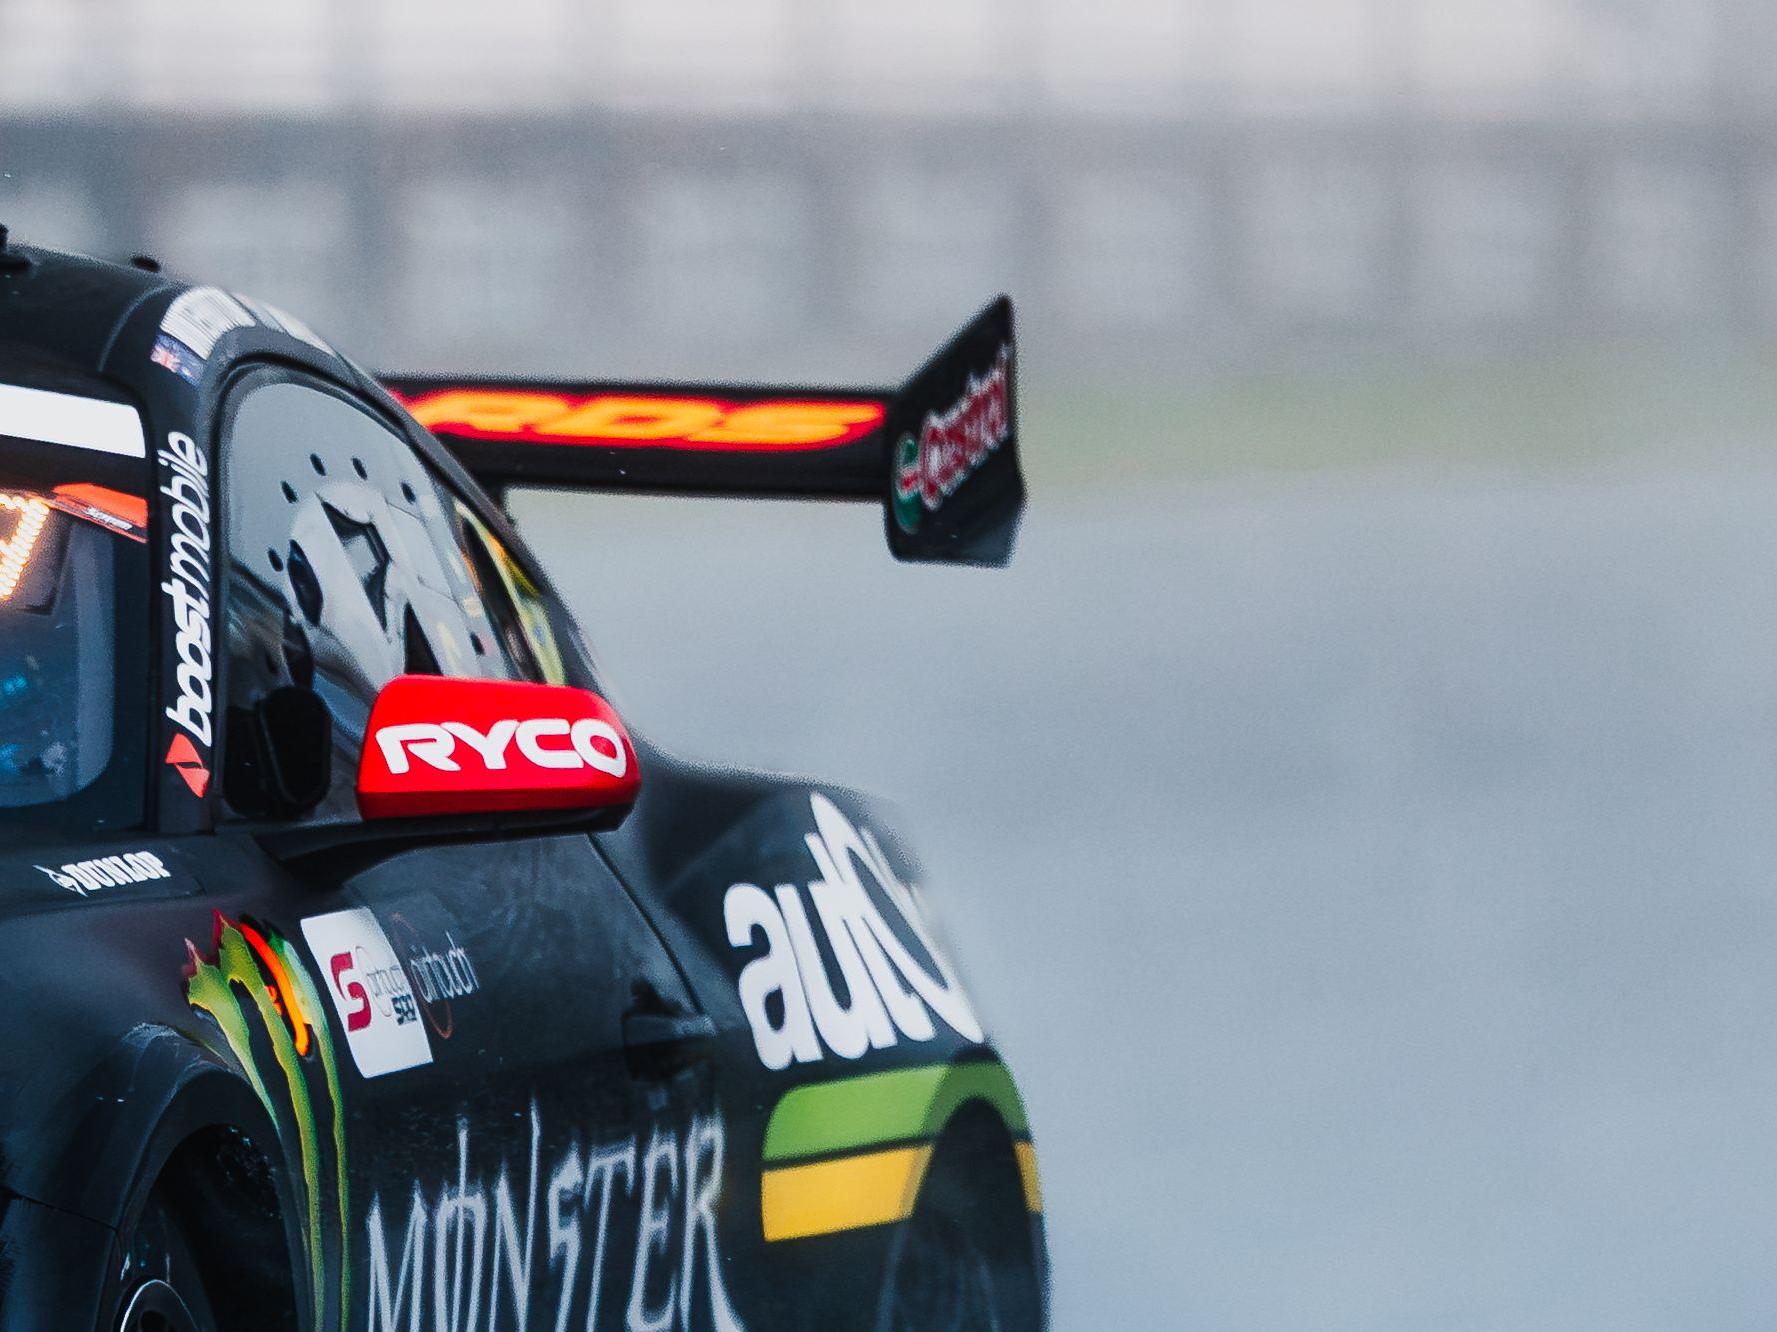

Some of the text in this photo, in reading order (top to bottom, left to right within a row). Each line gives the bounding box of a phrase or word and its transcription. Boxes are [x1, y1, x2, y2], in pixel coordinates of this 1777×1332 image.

[156, 431, 213, 748] boostmobile
[374, 718, 628, 778] RYCO
[59, 850, 172, 891] DUNLOP
[723, 790, 987, 1072] auto
